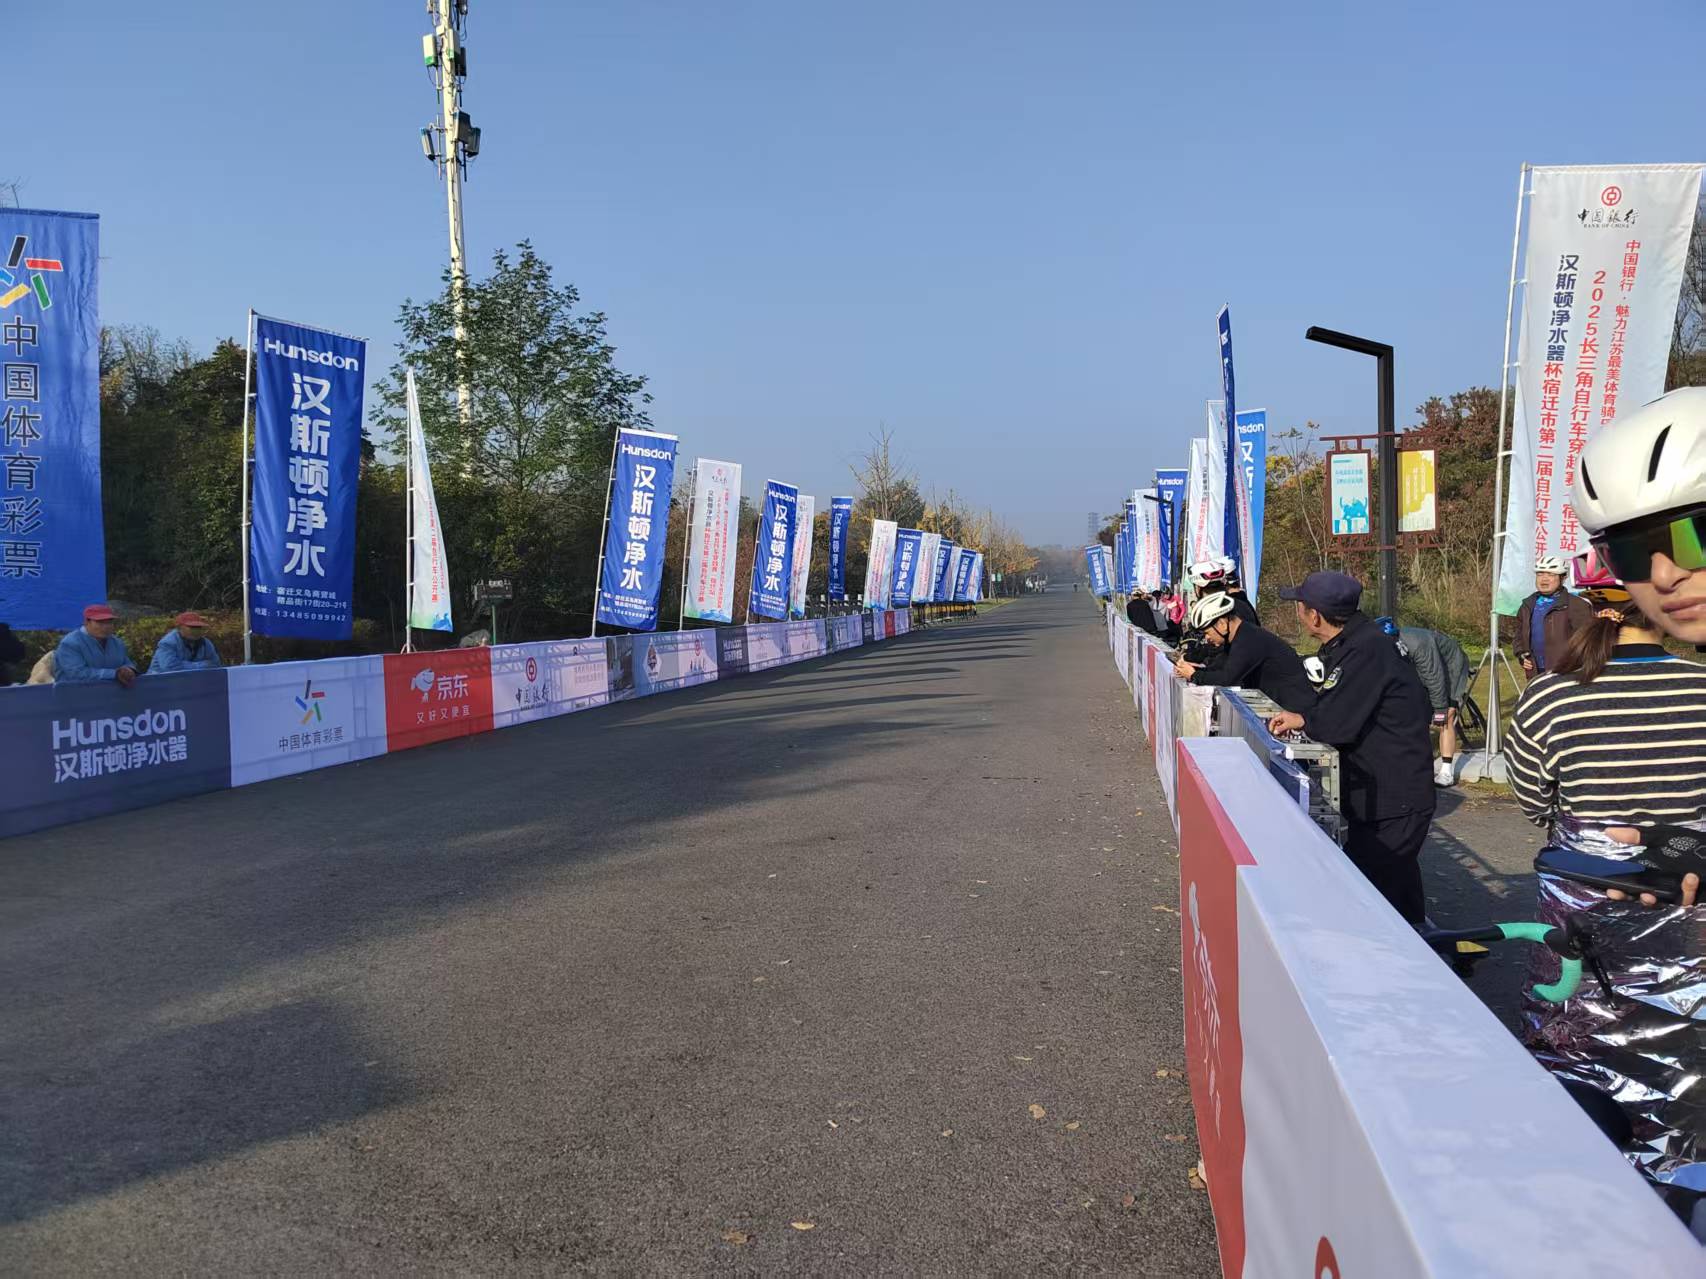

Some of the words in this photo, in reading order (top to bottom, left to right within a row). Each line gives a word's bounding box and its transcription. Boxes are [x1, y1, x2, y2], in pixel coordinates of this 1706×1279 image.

[1601, 239, 1641, 425] 中国银行·魅力江苏最美体育骑
[263, 337, 359, 372] Hunsdon
[0, 316, 43, 578] 中国体育彩票
[621, 443, 673, 461] Hunsdon
[283, 372, 331, 578] 汉斯顿净水
[620, 463, 657, 591] 汉斯顿净水
[437, 673, 469, 699] 京东
[52, 708, 187, 749] Hunsdon
[416, 704, 470, 724] 又好又便宜
[54, 735, 188, 784] 汉斯顿净水器
[278, 726, 344, 752] 中国体育彩票
